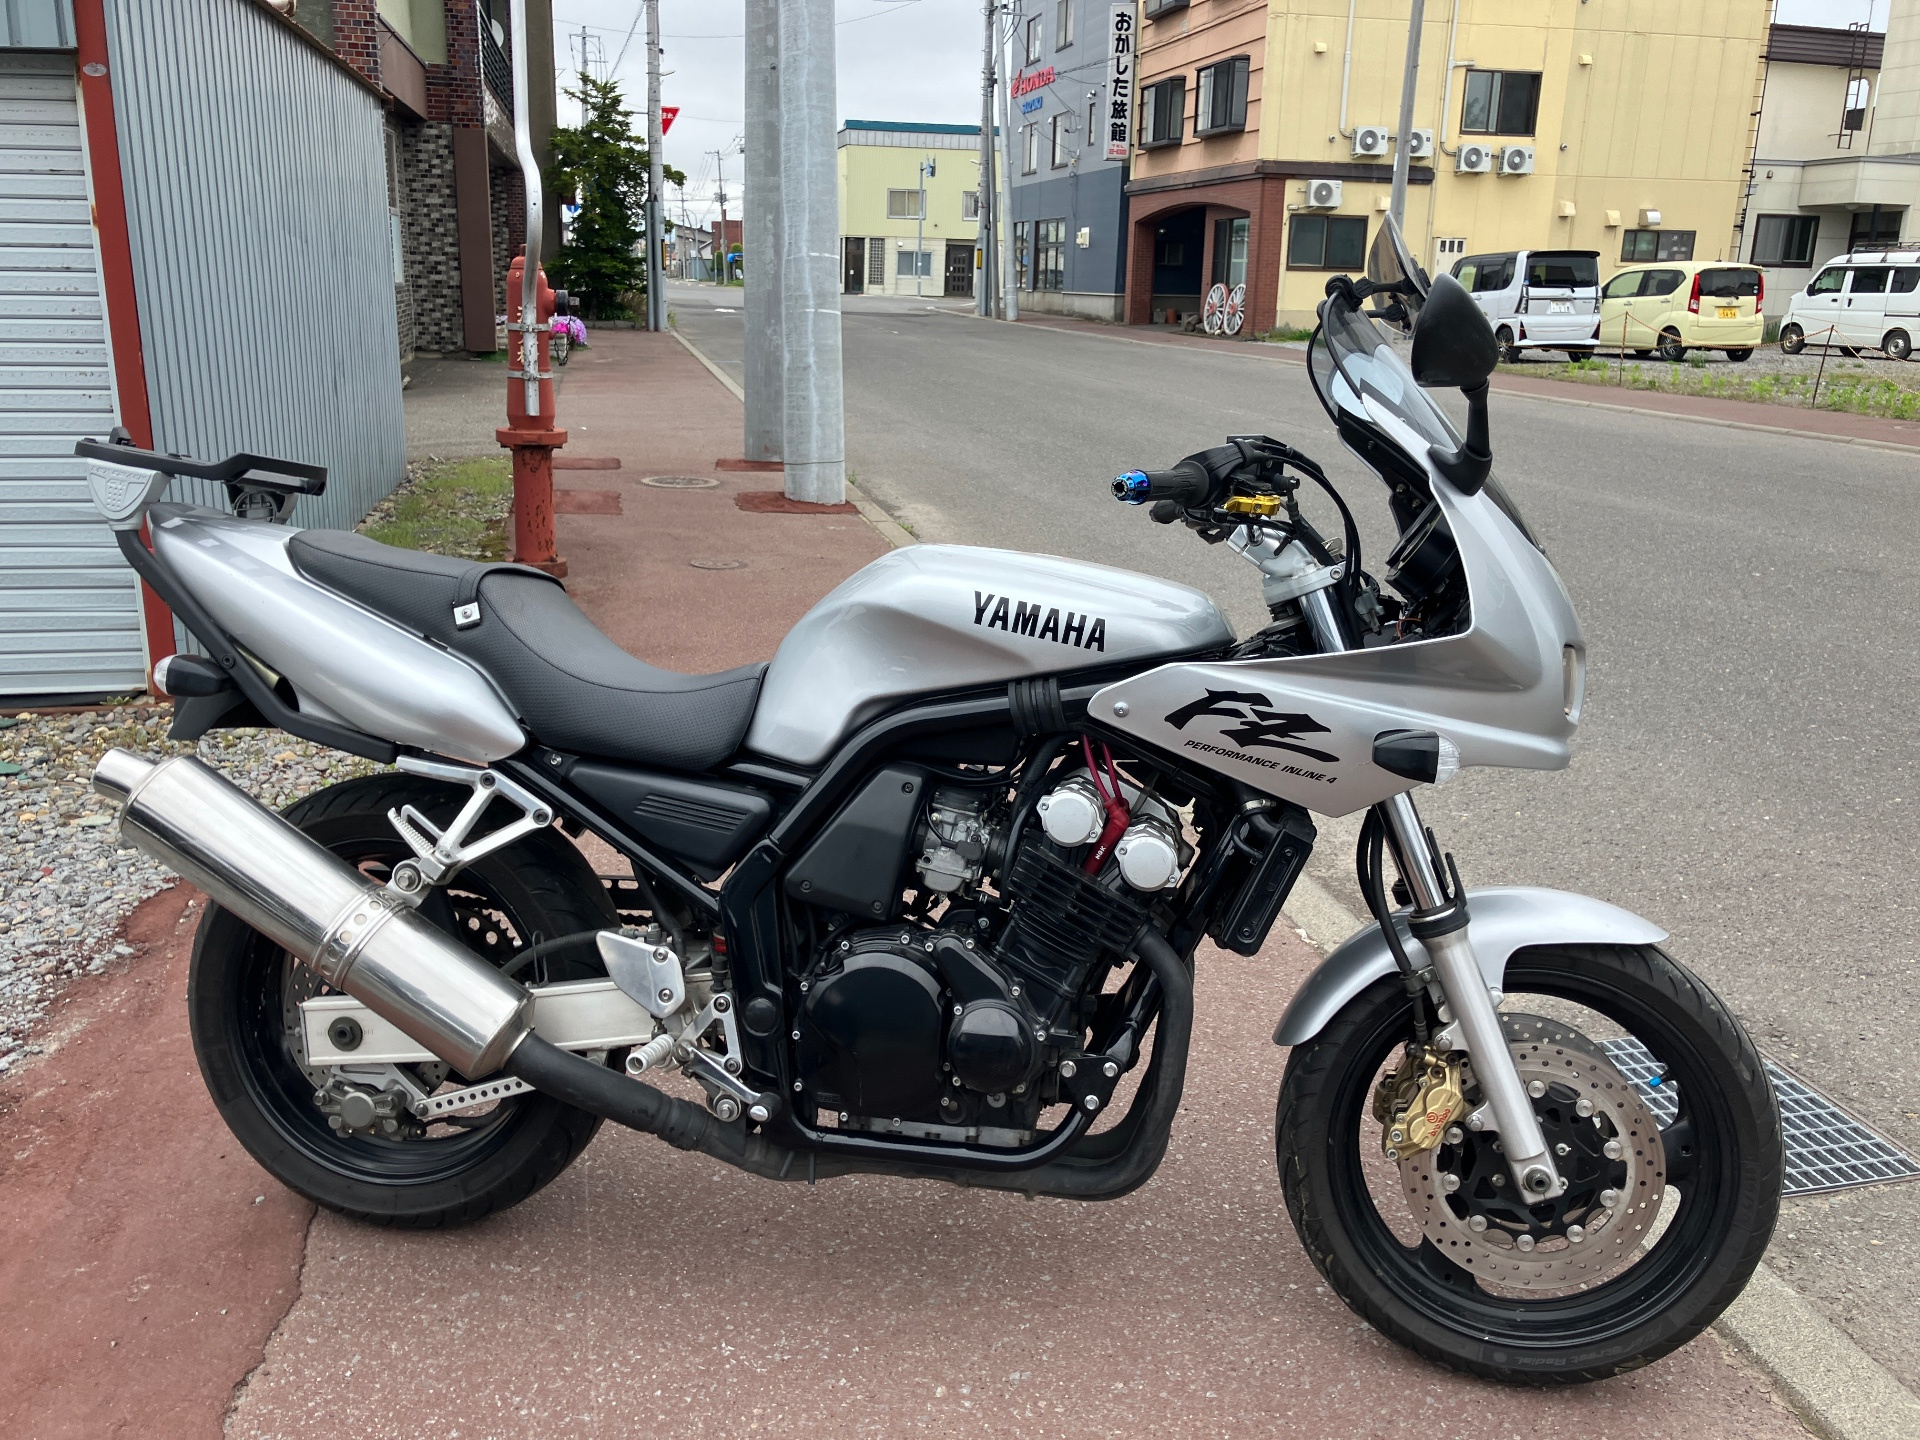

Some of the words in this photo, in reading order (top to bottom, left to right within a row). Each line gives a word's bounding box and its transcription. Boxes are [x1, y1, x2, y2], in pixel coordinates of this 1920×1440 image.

[1020, 66, 1056, 96] HONDA
[1110, 12, 1132, 142] おかした旅館
[973, 590, 1106, 653] YAMAHA
[1184, 739, 1280, 770] PERFORMANCE
[1281, 765, 1326, 782] INLINE
[1326, 776, 1338, 785] 4
[1095, 845, 1106, 860] NGK
[1515, 1356, 1567, 1366] Radial
